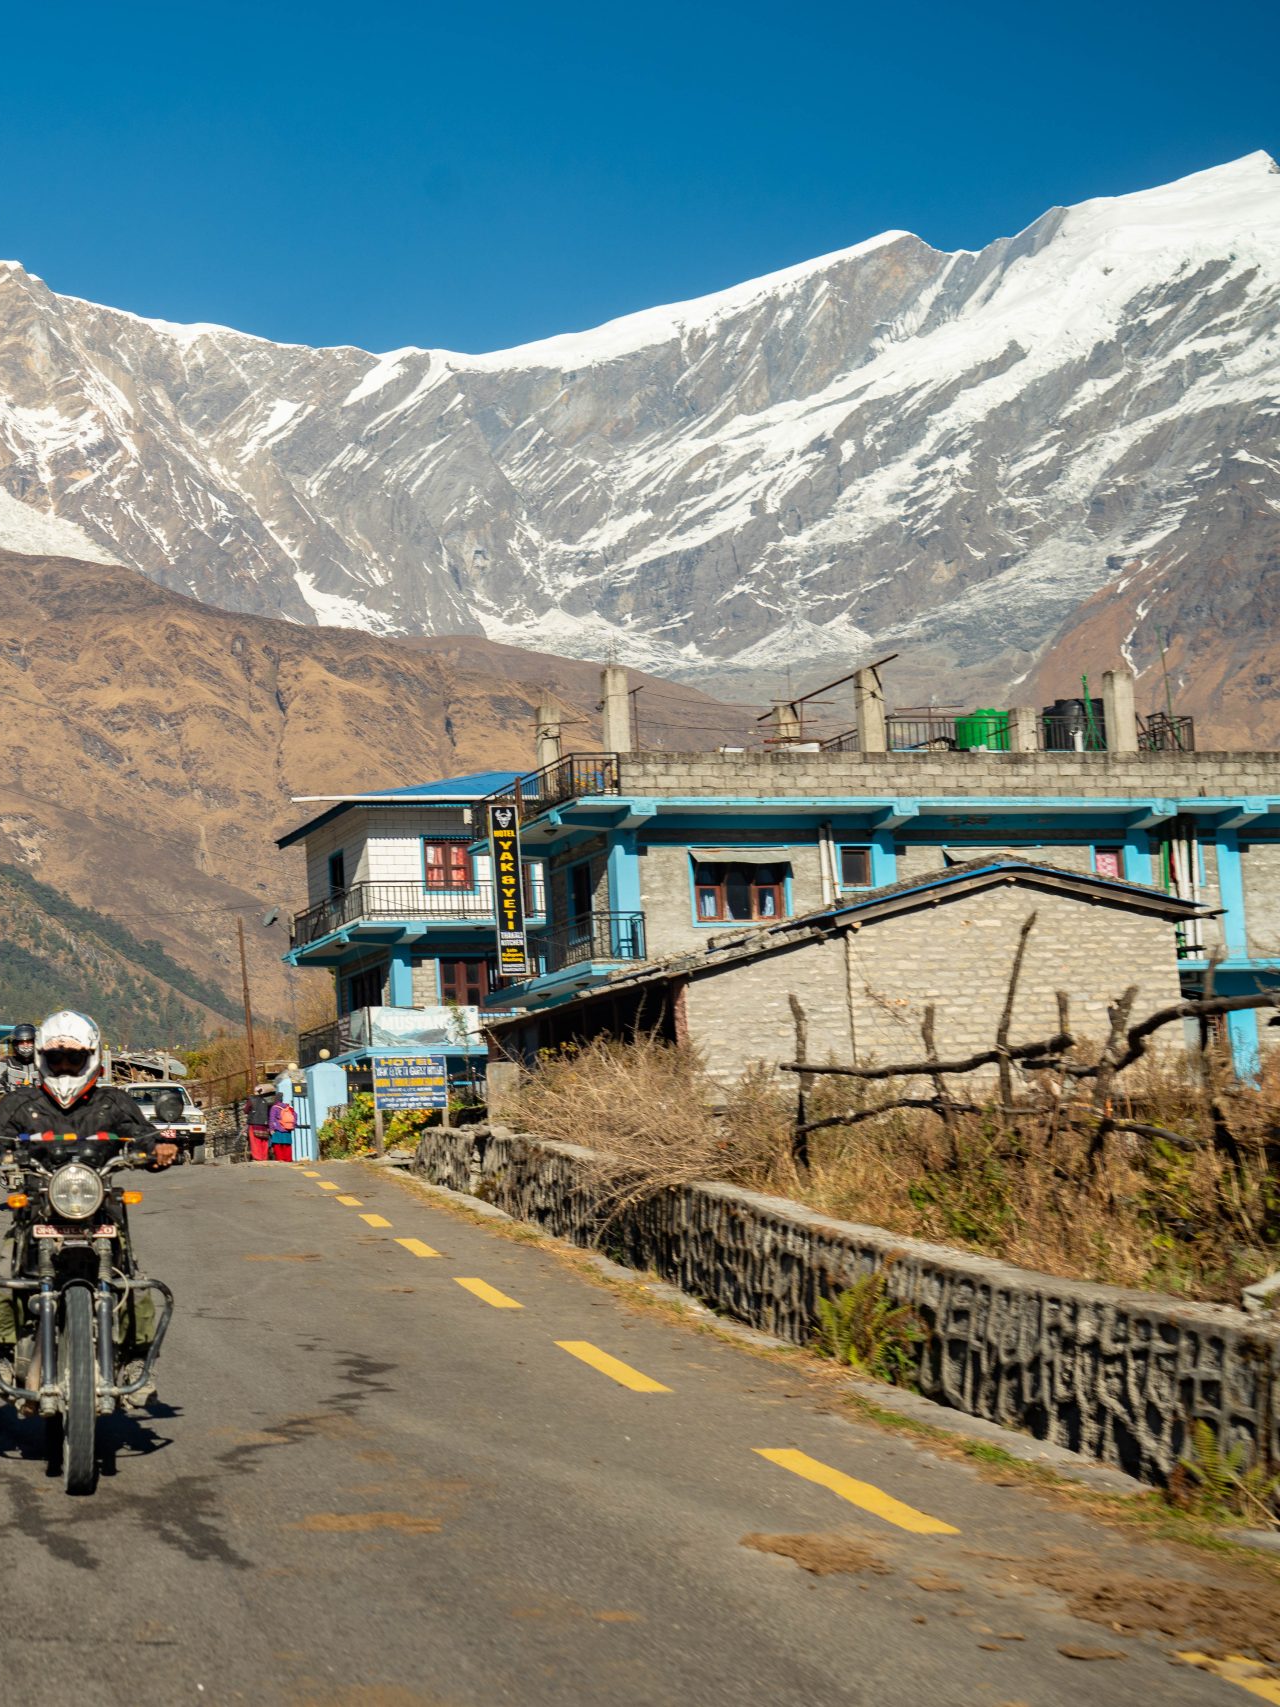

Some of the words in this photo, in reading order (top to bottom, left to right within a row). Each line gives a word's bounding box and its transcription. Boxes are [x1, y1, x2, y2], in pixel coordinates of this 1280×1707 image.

[493, 829, 516, 838] HOTEL
[499, 841, 515, 872] YAK
[501, 875, 516, 885] &
[501, 888, 517, 930] YETI
[380, 1015, 450, 1031] MUSTAN
[380, 1058, 439, 1066] HOTEL
